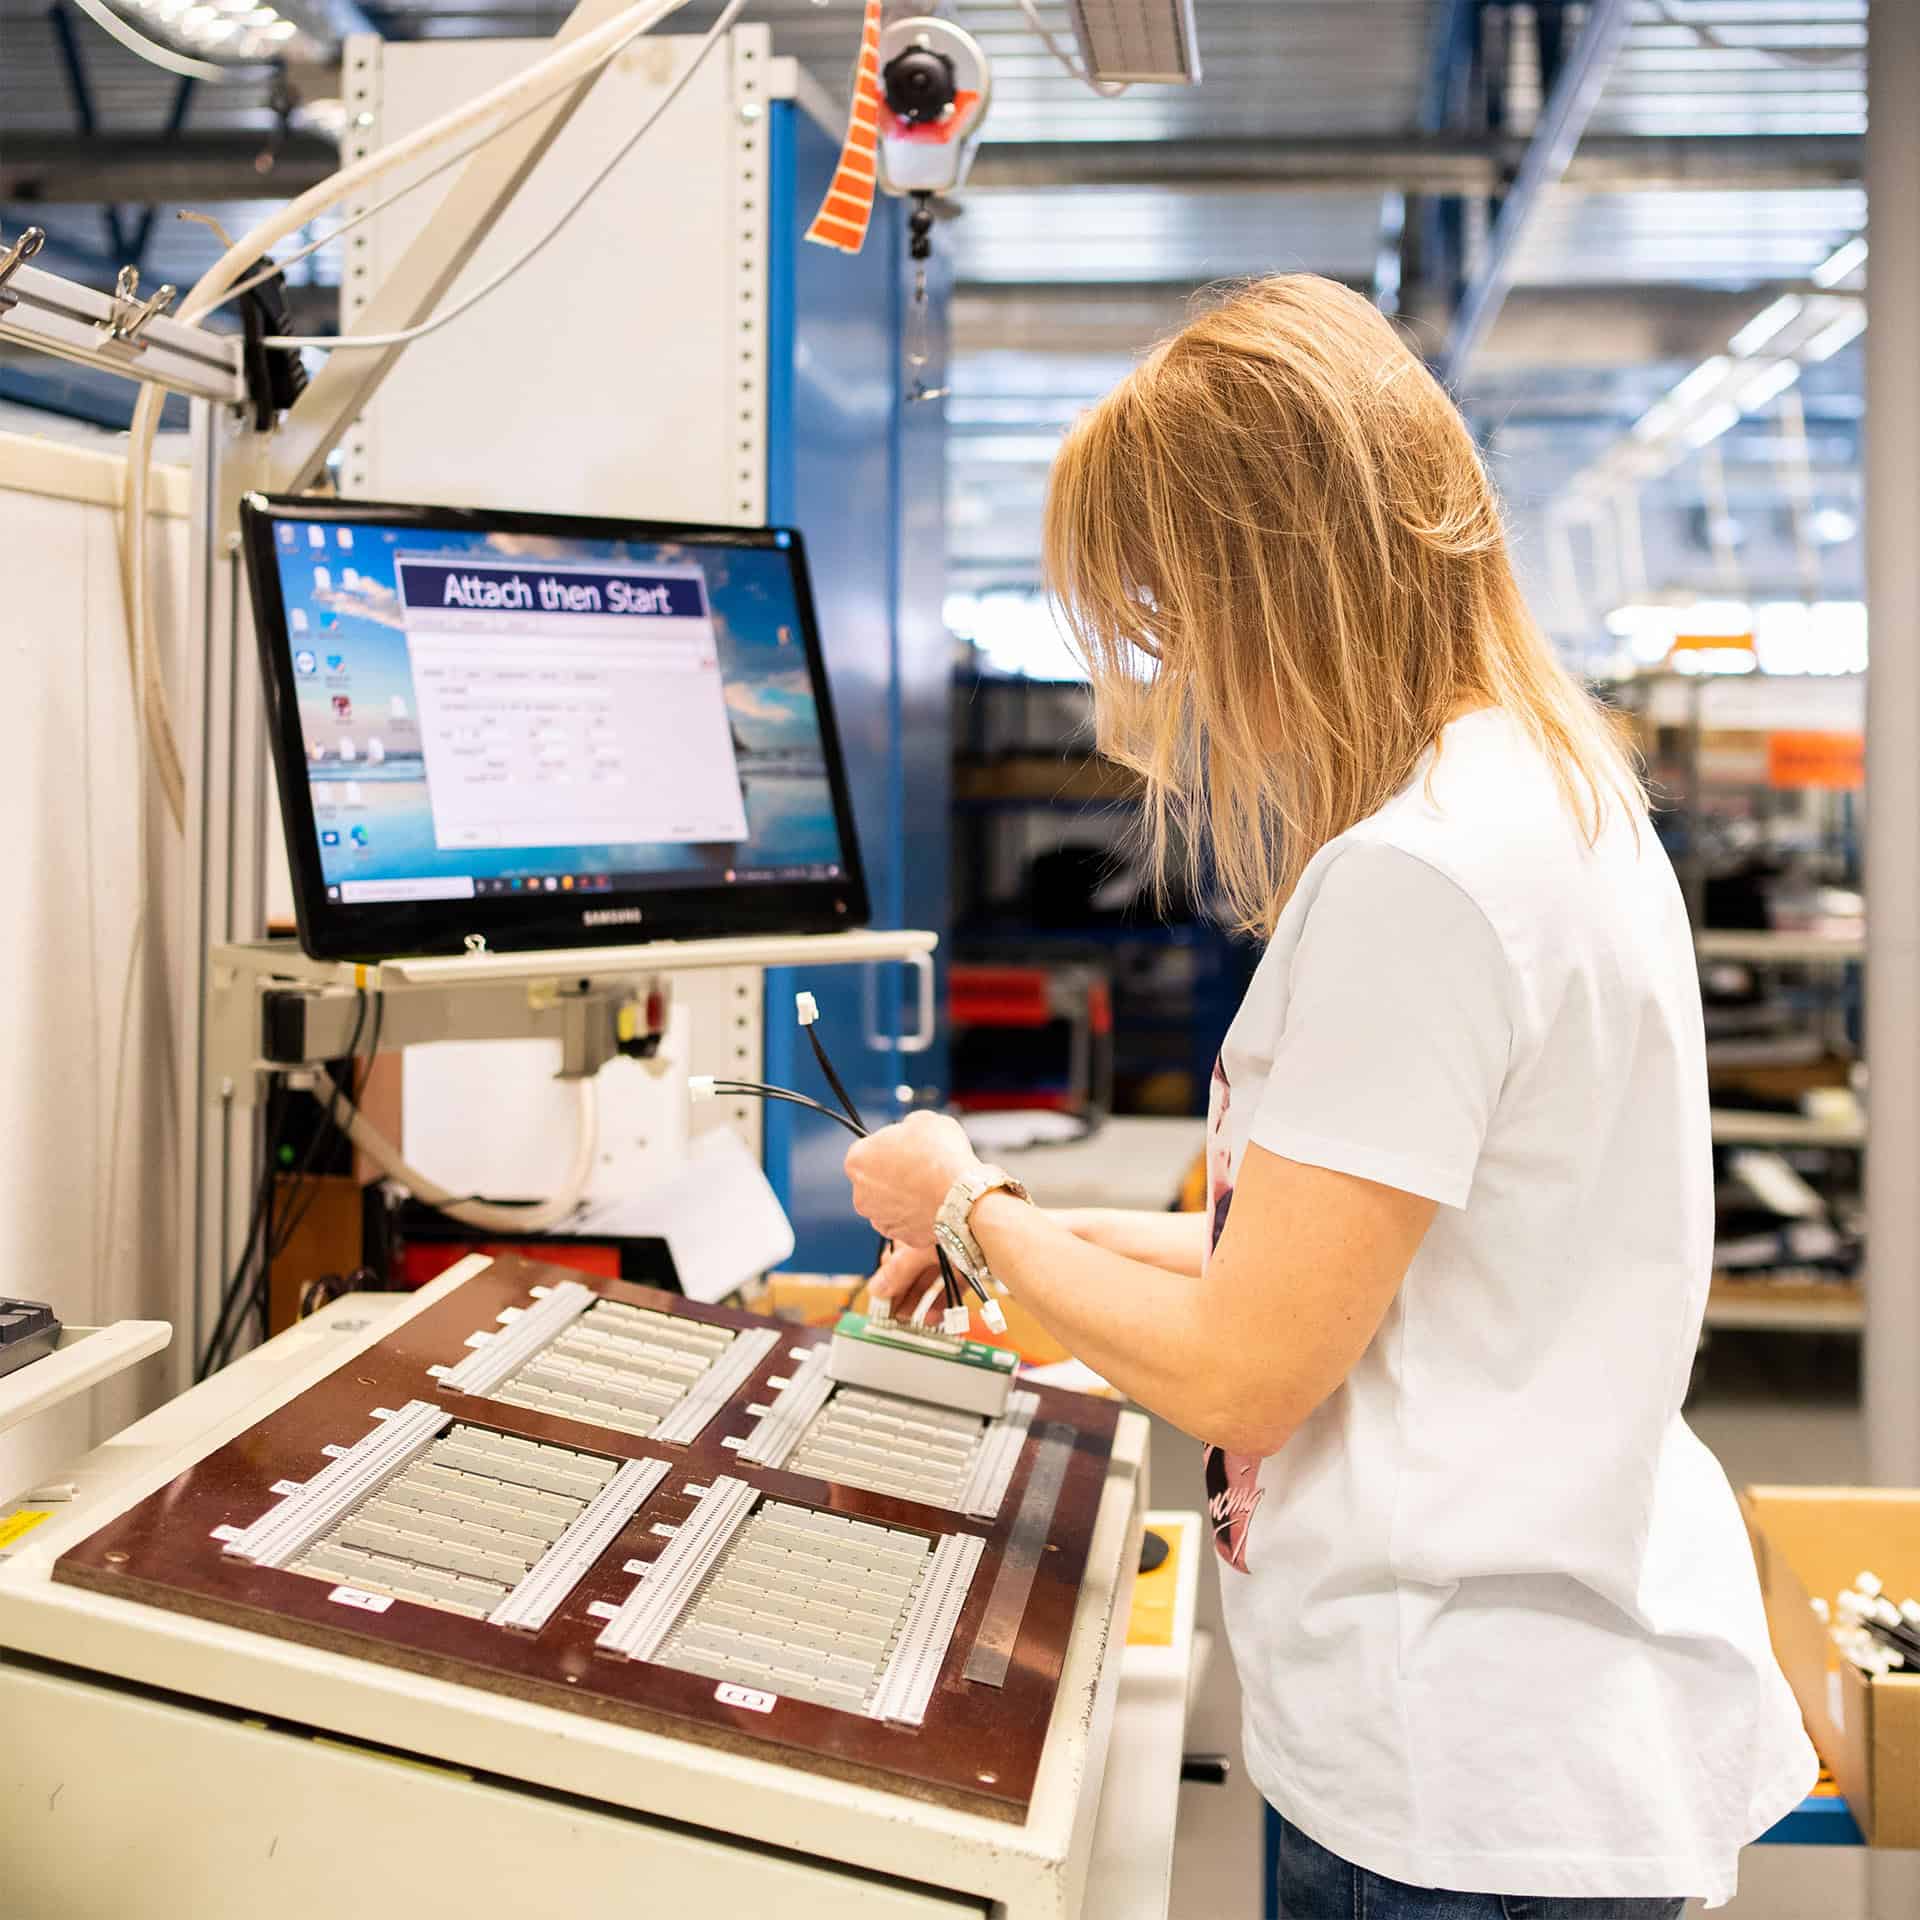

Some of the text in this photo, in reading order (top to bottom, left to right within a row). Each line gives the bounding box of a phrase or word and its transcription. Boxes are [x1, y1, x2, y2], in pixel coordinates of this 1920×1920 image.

[443, 573, 672, 614] Attach then Start
[583, 907, 642, 926] SAMSUNG
